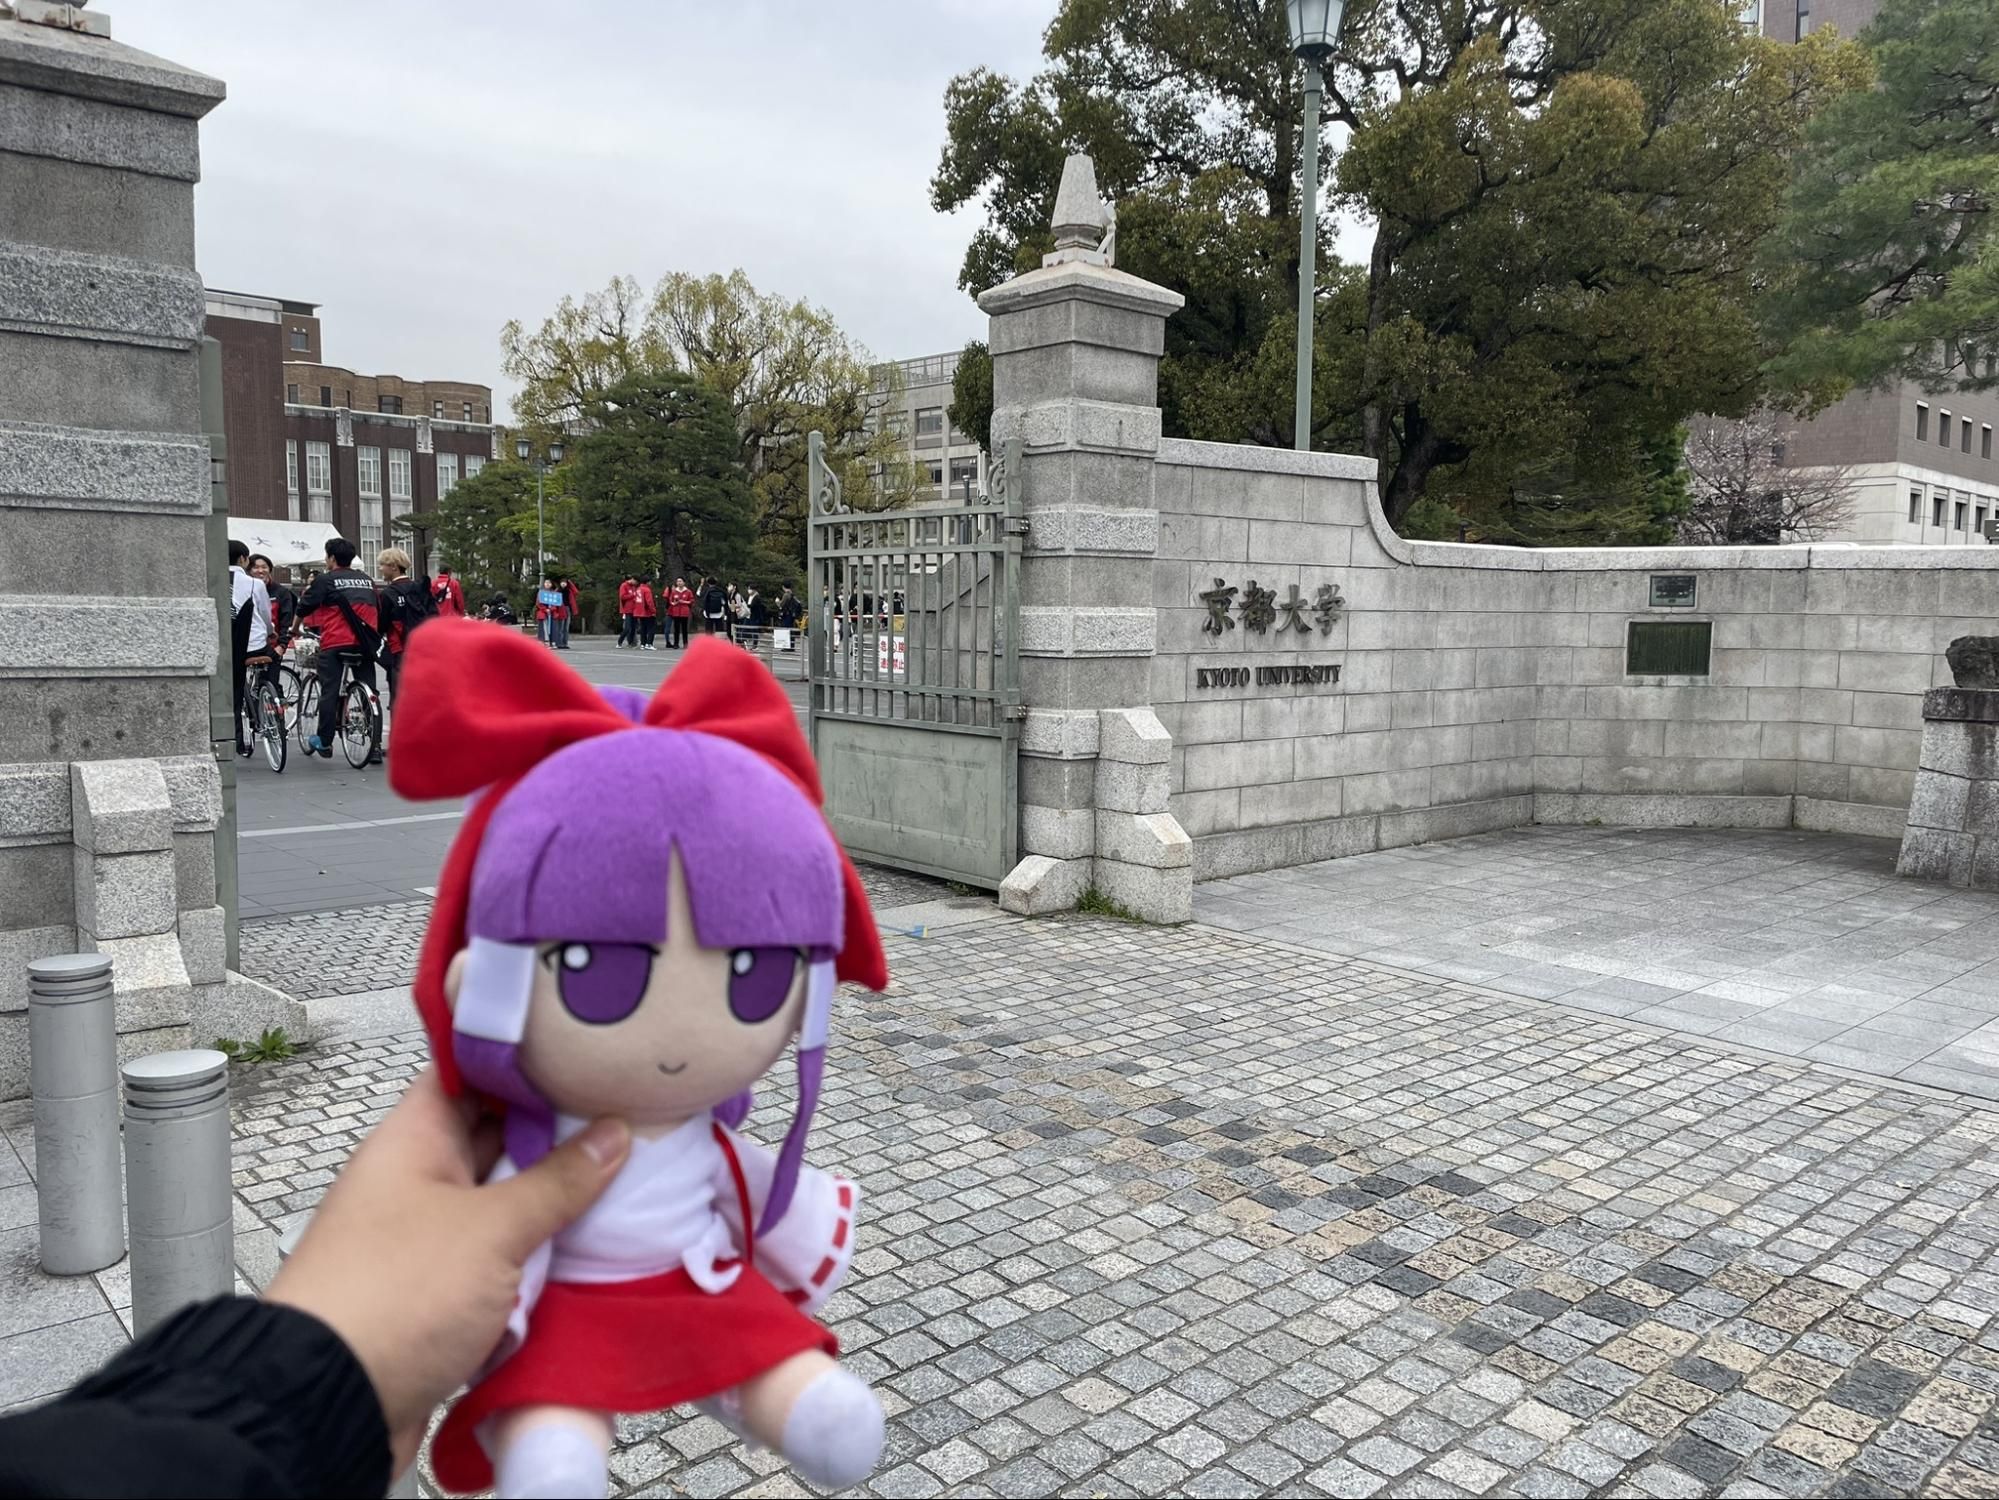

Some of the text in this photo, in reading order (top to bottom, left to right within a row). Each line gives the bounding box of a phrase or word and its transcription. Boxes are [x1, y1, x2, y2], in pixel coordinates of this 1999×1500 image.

[1199, 577, 1346, 637] 京都大学
[1196, 664, 1342, 689] KYOTO UNIVERSITY
